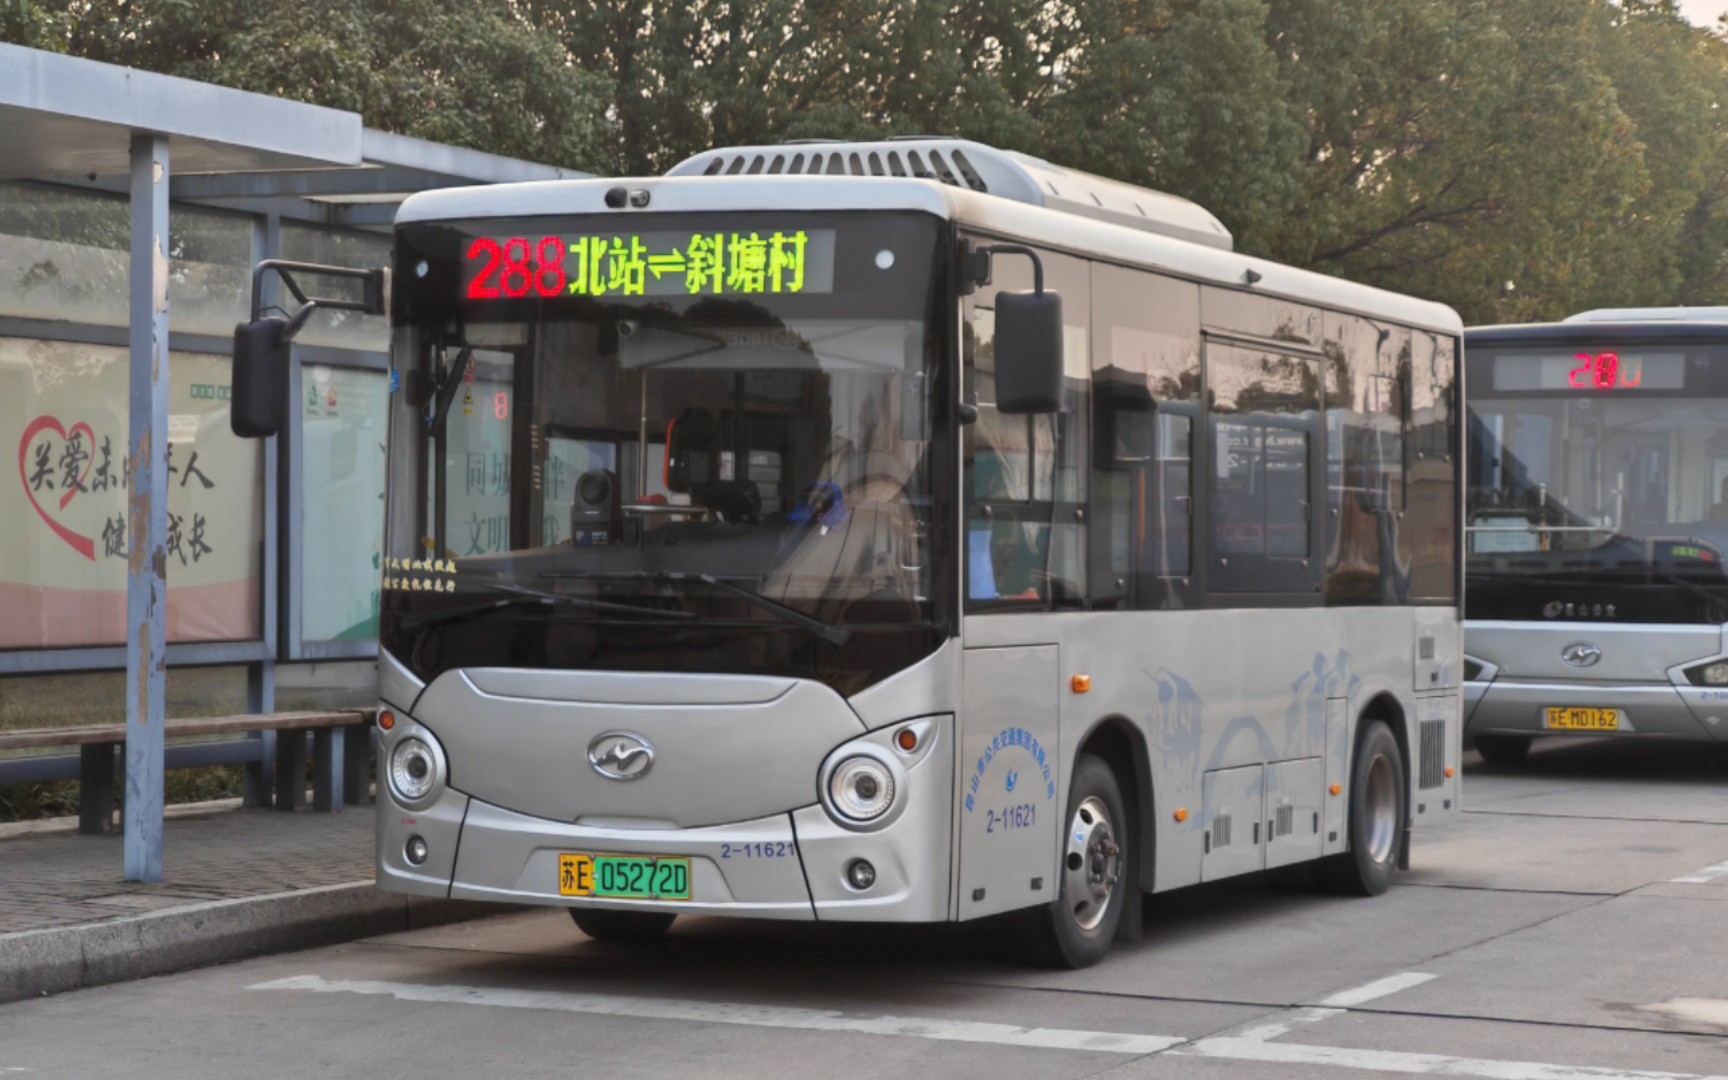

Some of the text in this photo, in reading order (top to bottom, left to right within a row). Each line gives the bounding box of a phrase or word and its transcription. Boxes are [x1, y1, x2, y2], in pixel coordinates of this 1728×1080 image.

[466, 230, 808, 299] 288 北站 斜塘村
[29, 431, 215, 494] 关爱未人
[102, 512, 213, 567] 健成长
[986, 803, 1036, 833] 2-11621
[721, 842, 796, 859] 2-11621
